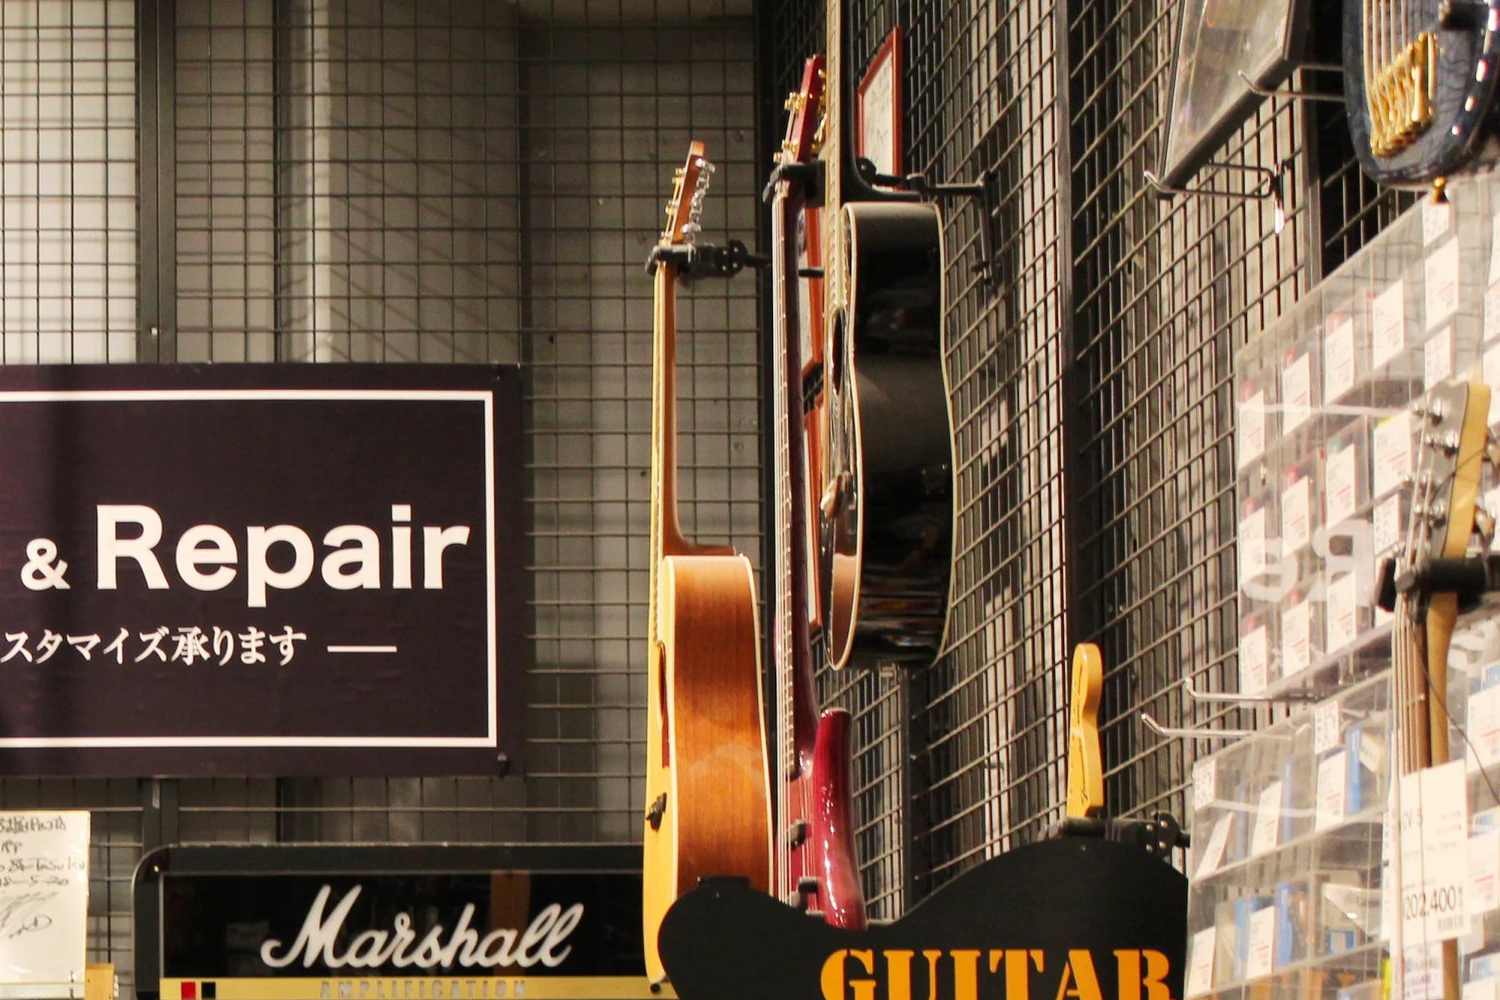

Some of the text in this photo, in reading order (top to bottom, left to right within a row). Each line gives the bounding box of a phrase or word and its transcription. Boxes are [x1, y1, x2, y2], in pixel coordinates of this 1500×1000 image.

[21, 538, 69, 592] &
[97, 503, 471, 607] Repair
[261, 884, 584, 968] Marshall
[319, 979, 527, 999] AMPLIFICATION
